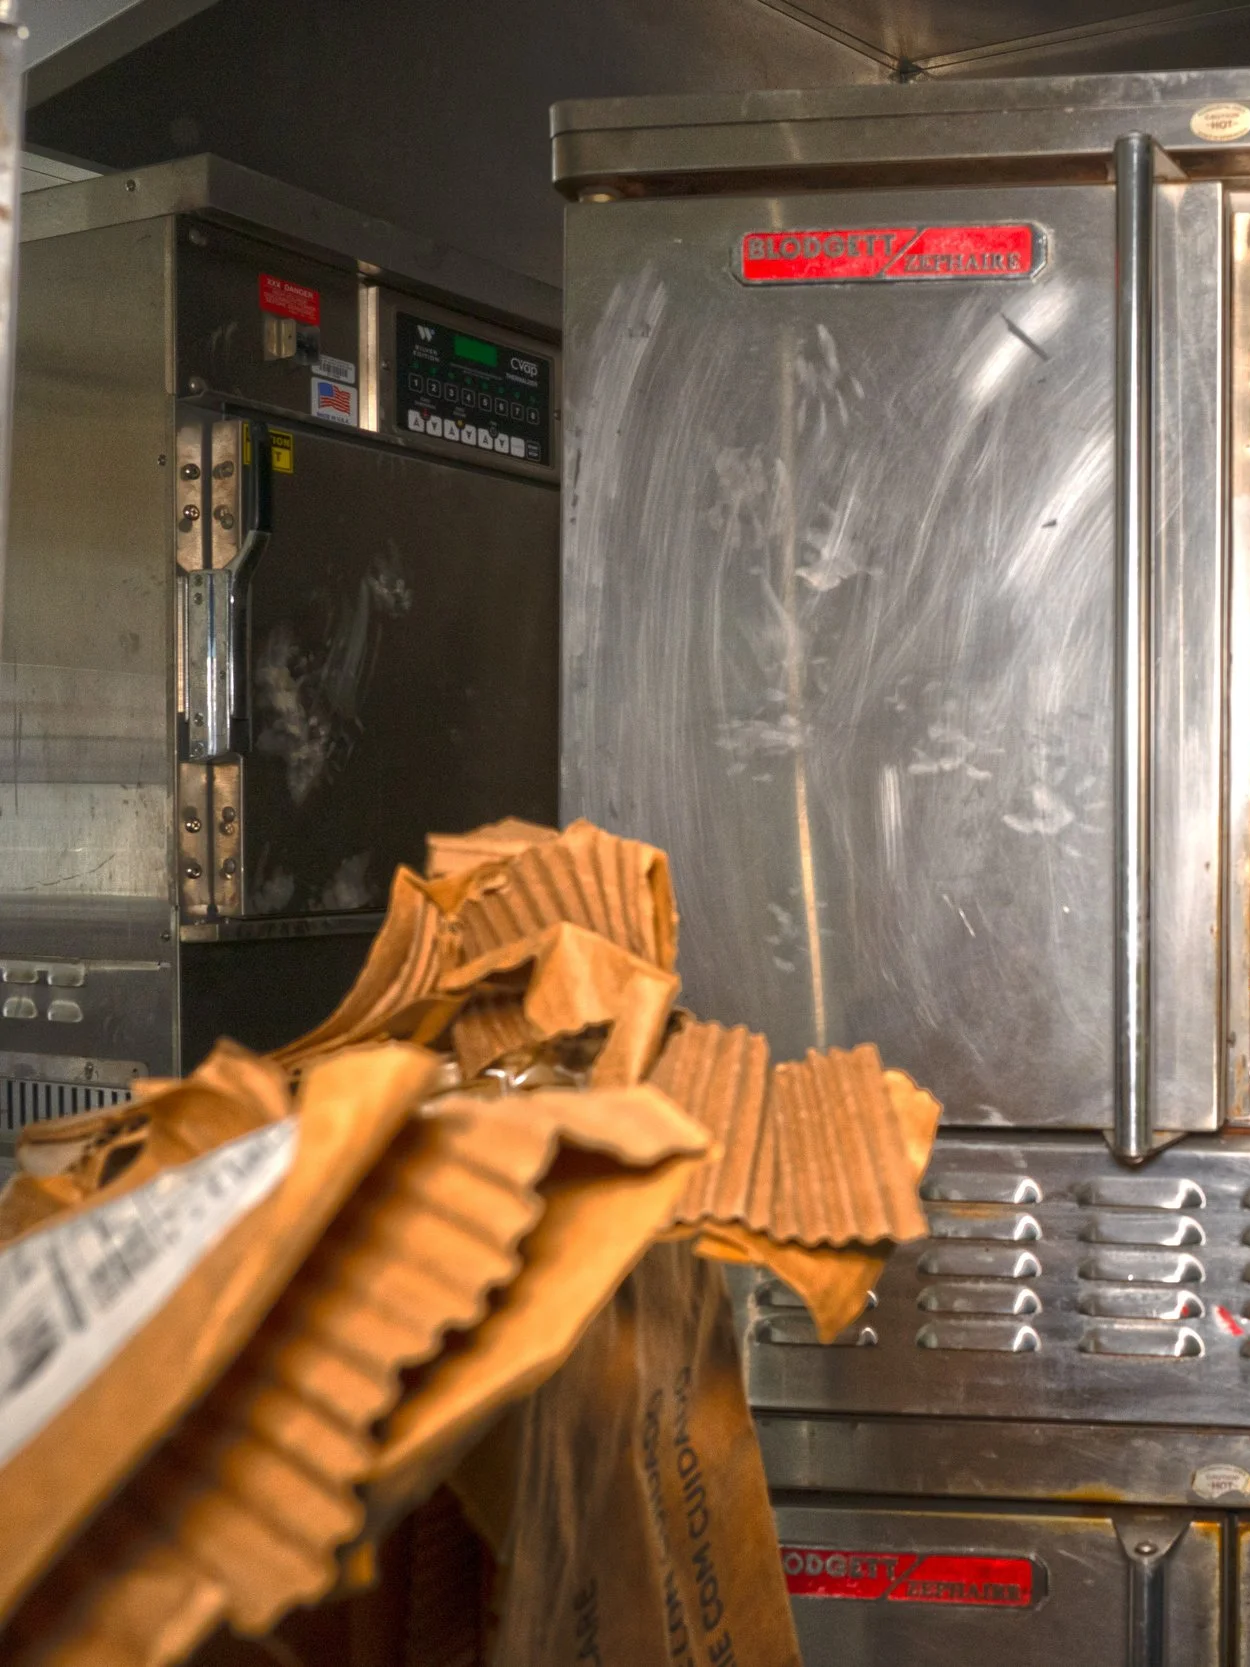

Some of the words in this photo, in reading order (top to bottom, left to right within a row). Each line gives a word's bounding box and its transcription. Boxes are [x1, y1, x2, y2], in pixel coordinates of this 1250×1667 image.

[749, 234, 897, 261] BLODGETT
[903, 252, 1021, 272] ZEPHAIRE
[284, 284, 314, 299] DANGER
[412, 350, 440, 362] EDITION
[272, 436, 291, 447] TION
[784, 1552, 899, 1581] ODGETT
[691, 1542, 724, 1632] COM
[573, 1579, 602, 1667] ARE
